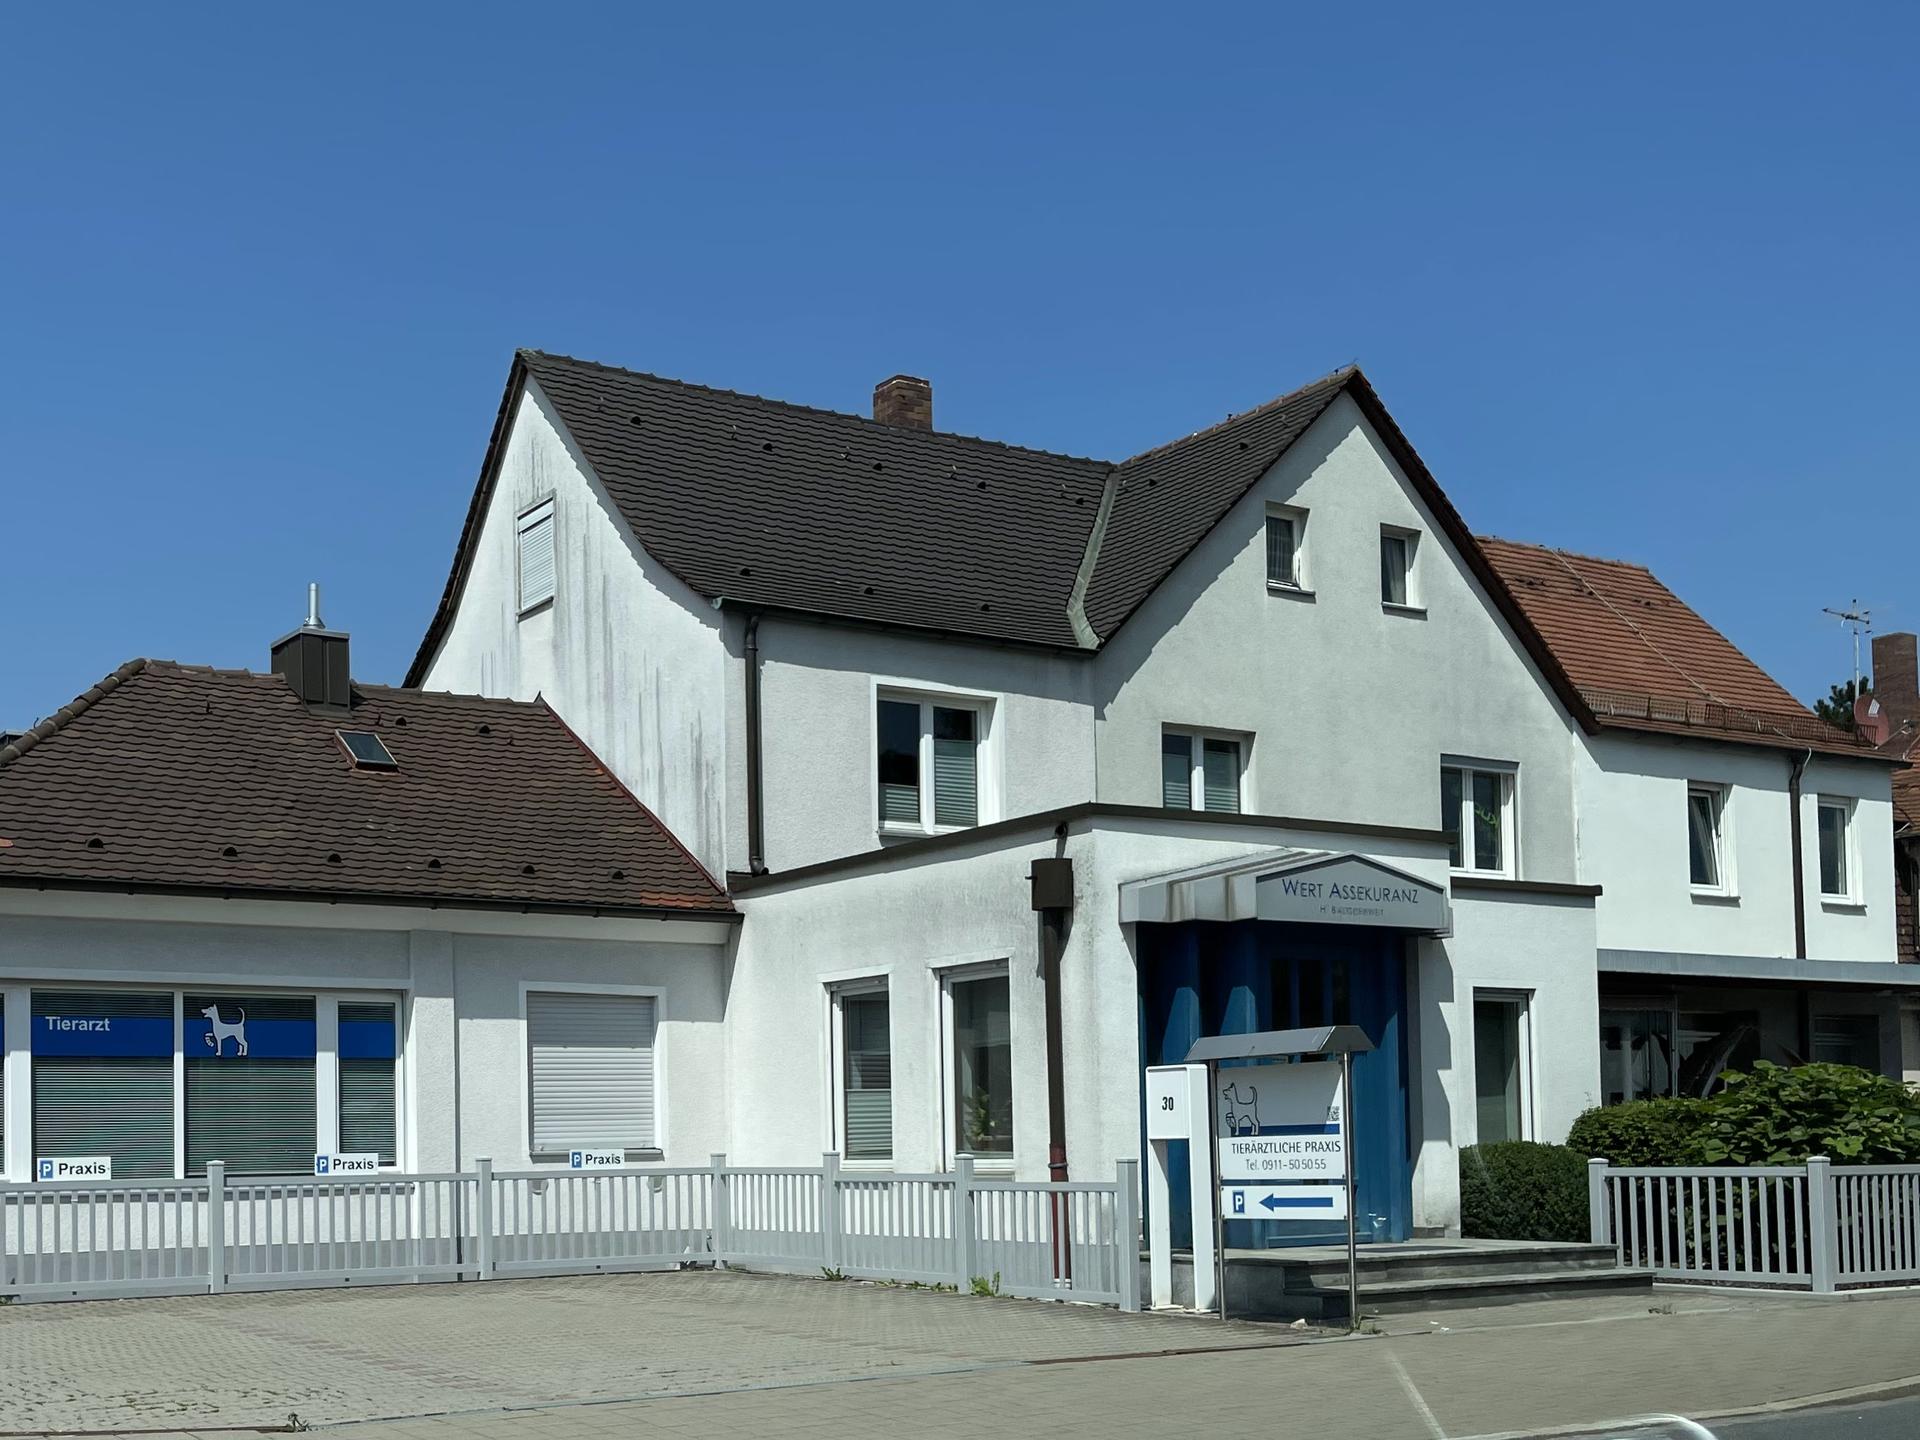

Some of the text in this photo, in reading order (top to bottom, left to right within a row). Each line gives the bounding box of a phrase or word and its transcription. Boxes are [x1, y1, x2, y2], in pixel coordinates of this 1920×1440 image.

[1329, 882, 1419, 904] ASSEKURANZ
[45, 1016, 110, 1031] Tierarzt
[1162, 1097, 1174, 1111] 30
[1232, 1140, 1341, 1154] TIERÄRZTLICHE PRAXIS
[333, 1158, 374, 1170] Praxis
[586, 1153, 621, 1165] Praxis
[1246, 1159, 1259, 1171] Tel.
[43, 1162, 106, 1176] P Praxis
[1235, 1194, 1243, 1211] P
